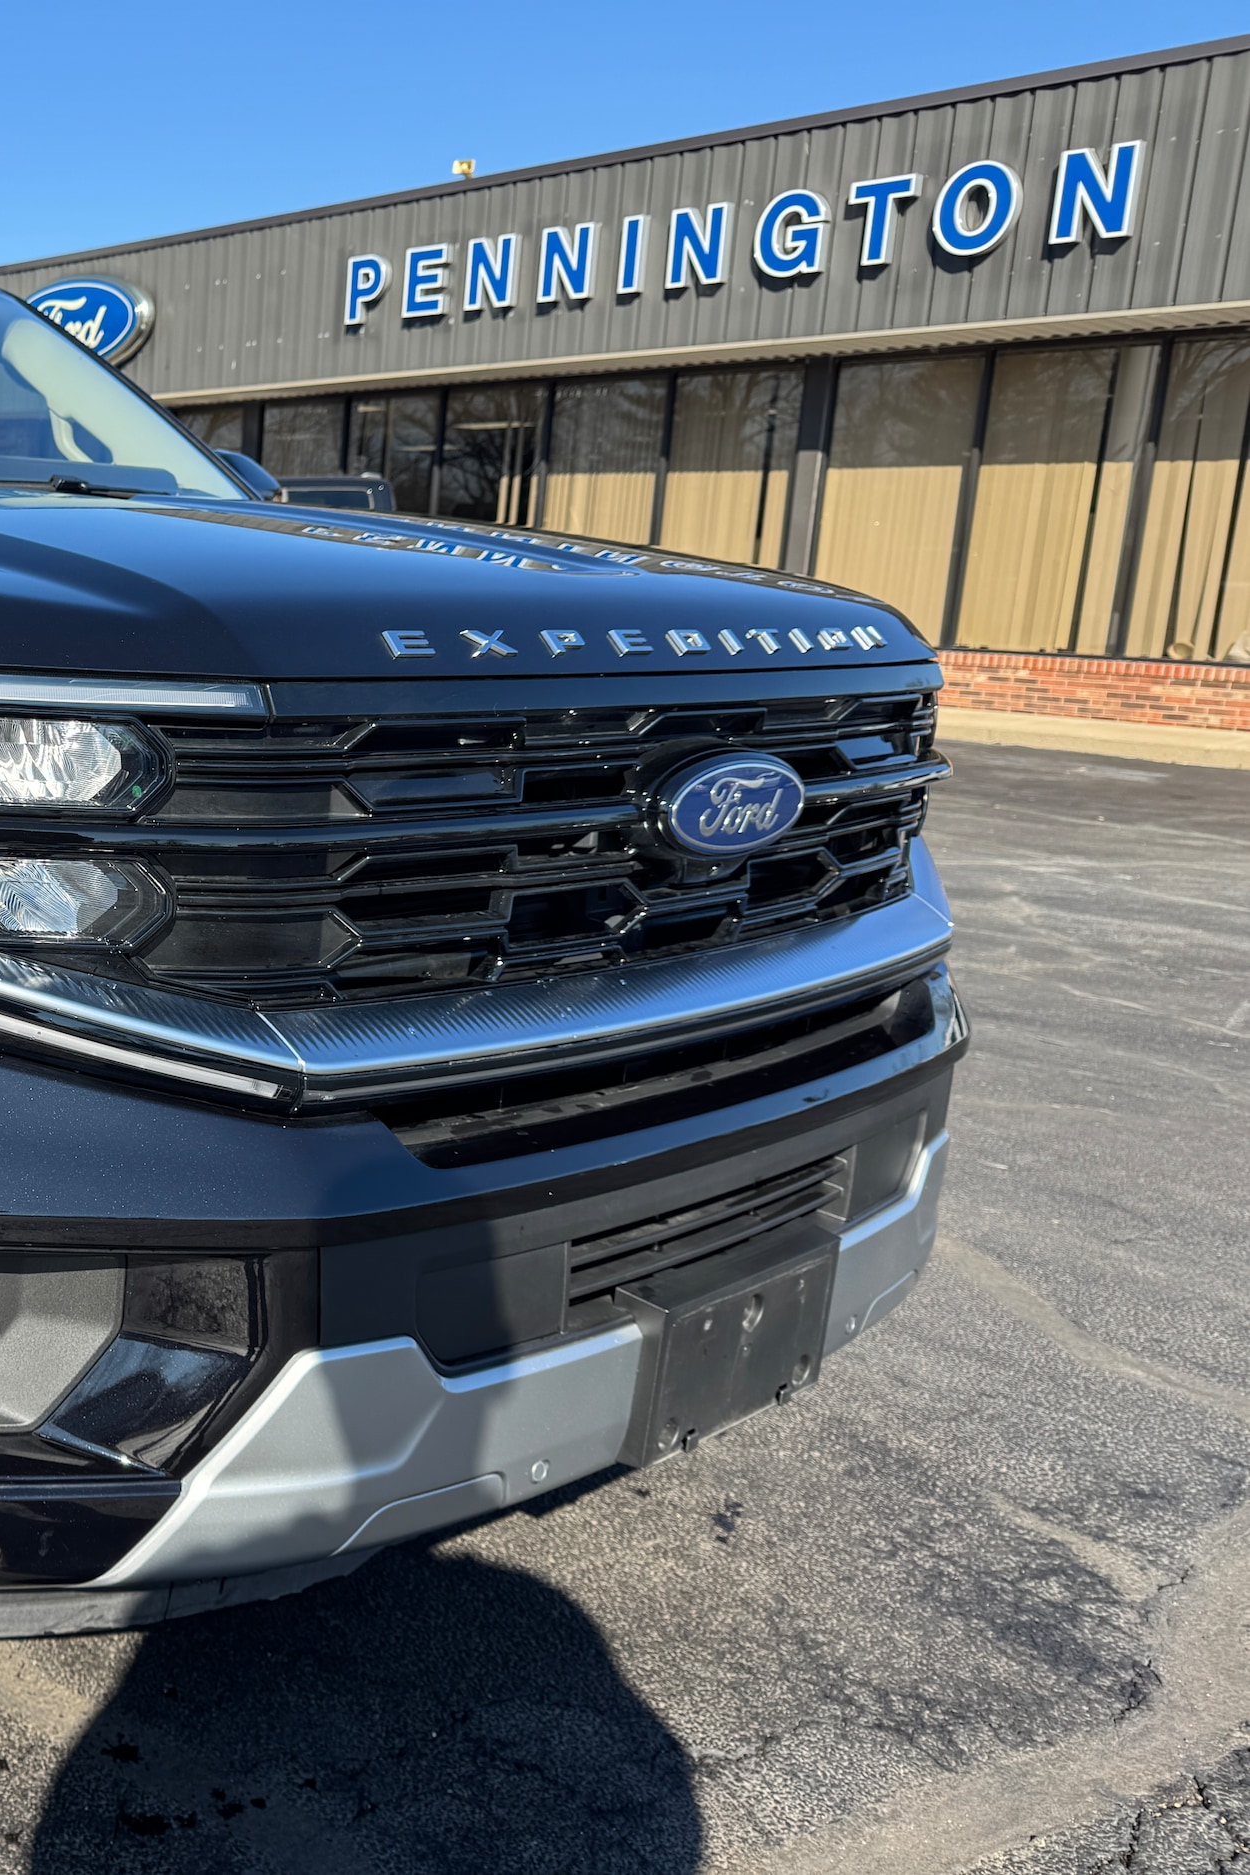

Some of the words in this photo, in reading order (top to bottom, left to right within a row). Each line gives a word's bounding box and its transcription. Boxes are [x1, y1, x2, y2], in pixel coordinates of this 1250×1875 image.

[344, 140, 1146, 325] PENNINGTON
[382, 626, 889, 660] EXPEDITION
[700, 777, 784, 837] Ford
